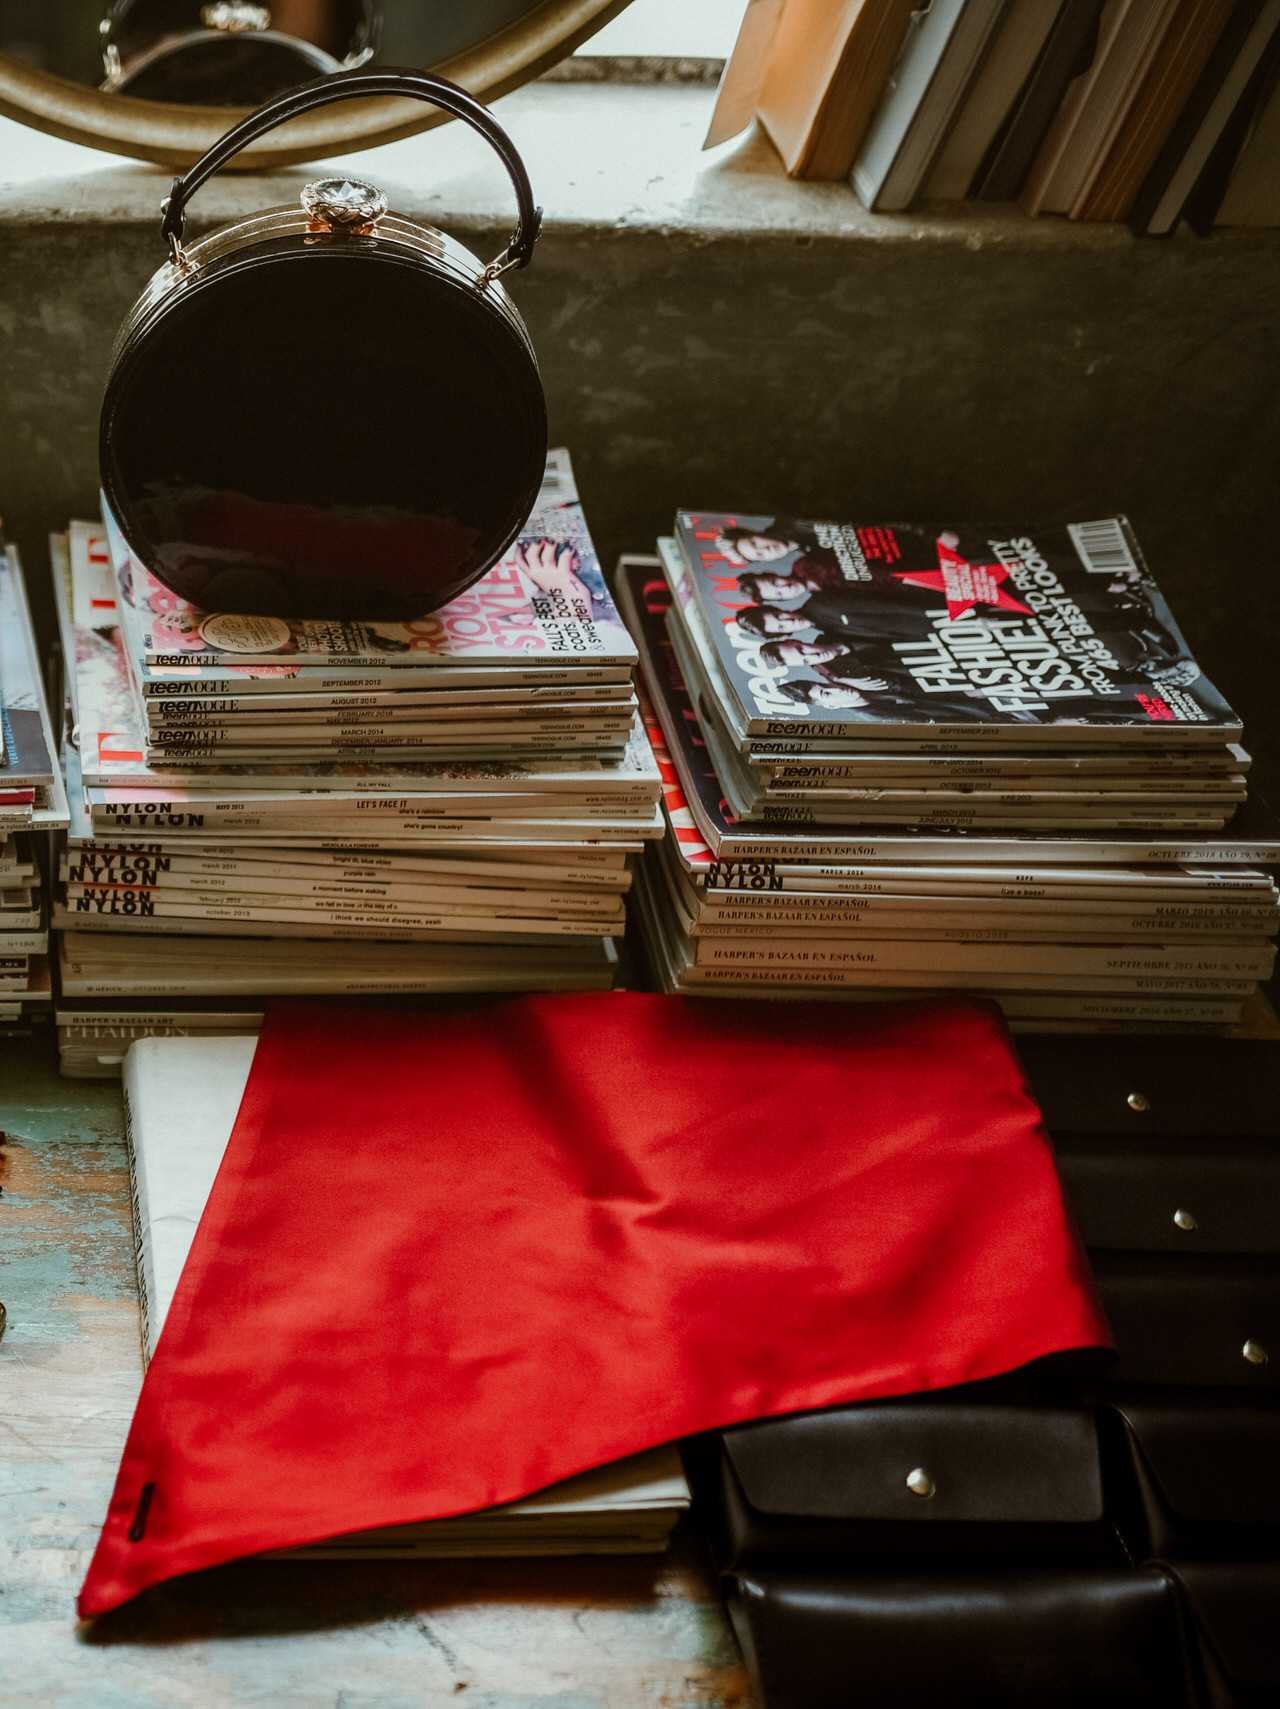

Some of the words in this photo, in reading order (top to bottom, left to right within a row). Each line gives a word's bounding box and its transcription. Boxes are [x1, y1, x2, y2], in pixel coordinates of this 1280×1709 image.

[987, 539, 1039, 591] PRETTY
[1011, 536, 1066, 597] LOOKS
[531, 595, 555, 620] BEST
[550, 588, 572, 620] boots
[1024, 591, 1053, 614] TO
[571, 597, 603, 645] sweaters
[1049, 597, 1095, 638] BEST
[313, 622, 333, 651] PHOTO
[541, 621, 570, 652] FALL'S
[1038, 611, 1084, 656] PUNK
[925, 608, 1051, 713] FASHION
[1079, 638, 1122, 671] 465
[891, 632, 976, 694] FALL
[1070, 654, 1122, 696] FROM
[321, 680, 363, 688] SEPTEMBER
[330, 698, 359, 706] AUGUST
[105, 803, 172, 815] NYLON
[356, 800, 378, 810] LET'S
[378, 800, 398, 809] FACE
[399, 800, 408, 808] IT
[115, 813, 205, 827] NYLON
[419, 823, 437, 831] gone
[438, 823, 463, 831] country!
[733, 846, 780, 858] HARPER'S
[781, 846, 819, 858] BAZAAR
[820, 847, 832, 858] EN
[833, 845, 877, 860] ESPAÑOL
[1148, 851, 1192, 859] OCTUBRE
[80, 853, 171, 871] NYLON
[708, 862, 776, 875] NYLON
[69, 866, 158, 886] NYLON
[343, 870, 363, 878] purple
[704, 875, 784, 890] NYLON
[83, 889, 151, 902] NYLON
[76, 898, 156, 915] NYLON
[725, 896, 773, 907] HARPER'S
[774, 897, 812, 908] BAZAAR
[812, 898, 825, 908] EN
[827, 898, 871, 910] ESPAÑOL
[718, 910, 765, 921] HARPER'S
[766, 911, 803, 922] BAZAAR
[803, 911, 817, 922] EN
[819, 911, 862, 923] ESPAÑOL
[1156, 908, 1189, 916] MARZO
[367, 915, 389, 924] should
[391, 917, 423, 927] disagree,
[1132, 920, 1178, 929] OCTUBRE
[713, 950, 765, 962] HARPER'S
[768, 951, 810, 962] BAZAAR
[812, 952, 827, 962] EN
[829, 951, 877, 964] ESPAÑOL
[1107, 960, 1170, 970] SEPTIEMBRE
[704, 971, 751, 981] HARPER'S
[751, 971, 788, 982] BAZAAR
[789, 972, 802, 982] EN
[803, 971, 847, 984] ESPAÑOL
[1136, 980, 1162, 989] MAYO
[72, 1016, 115, 1024] HARPER'S
[115, 1016, 154, 1024] BAZAAR
[65, 1025, 189, 1039] PHAIDON
